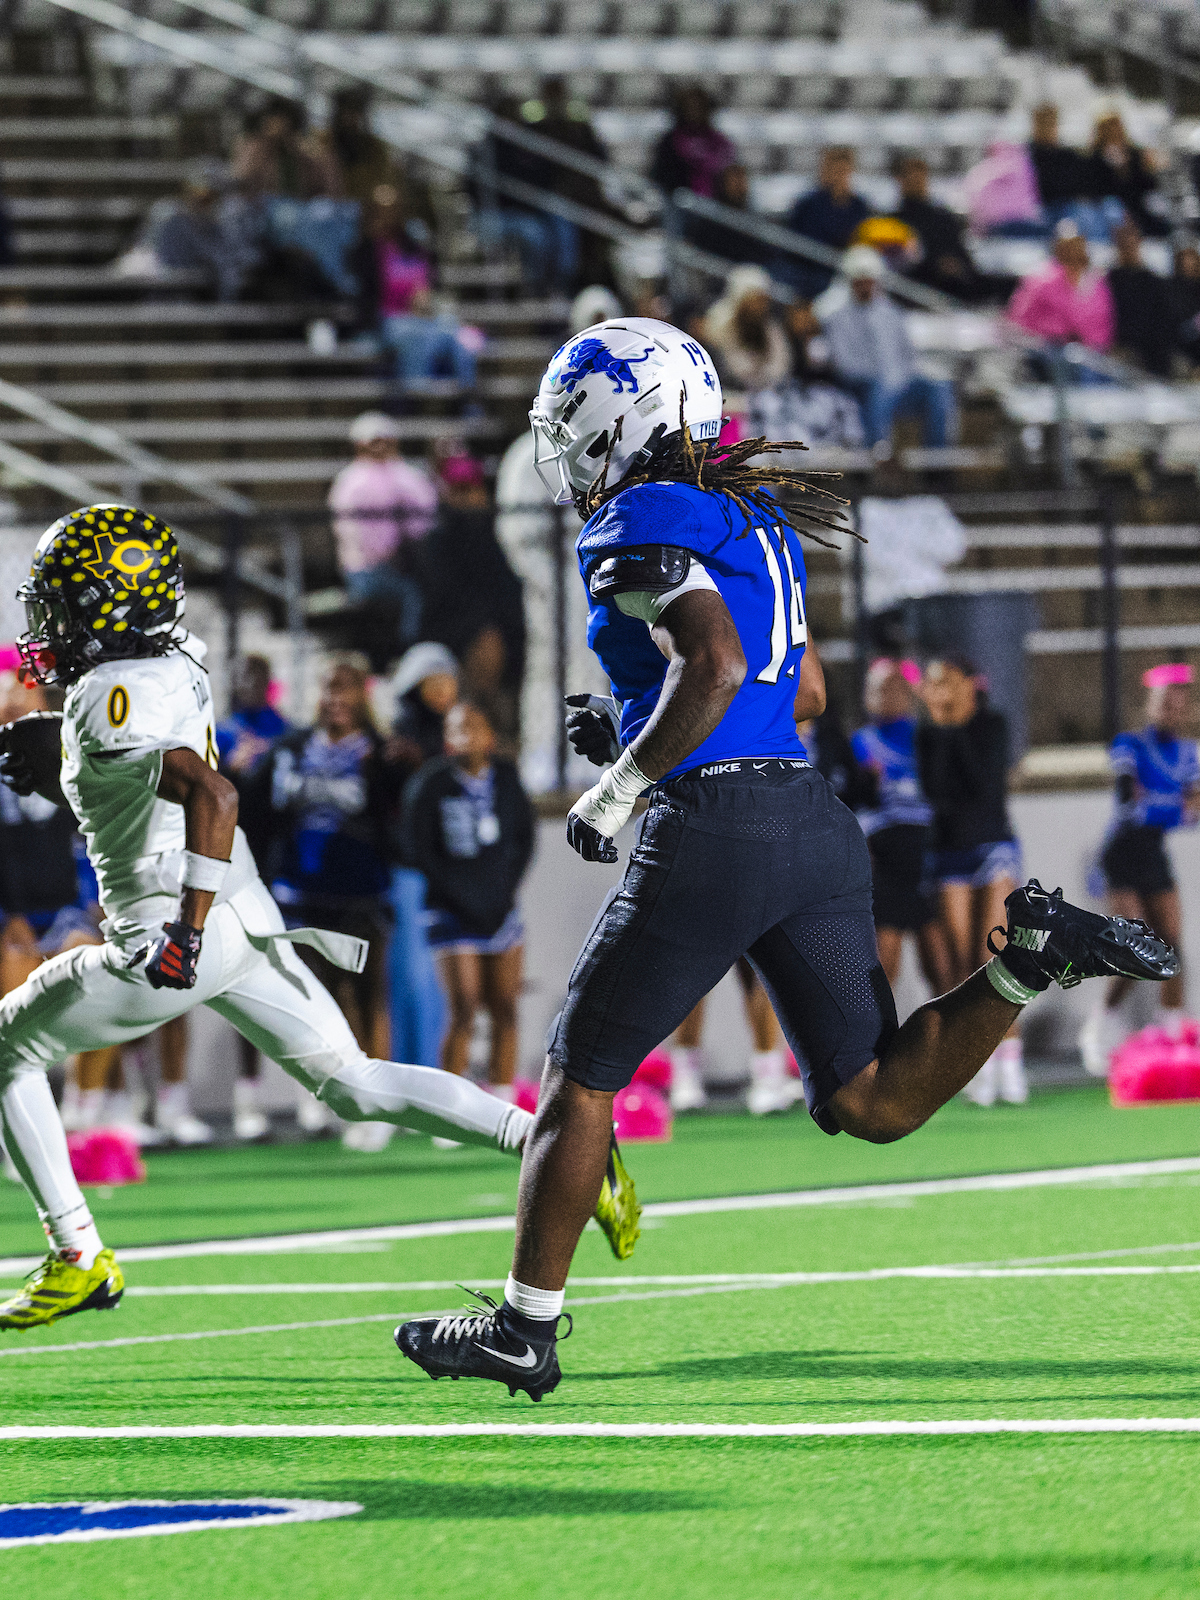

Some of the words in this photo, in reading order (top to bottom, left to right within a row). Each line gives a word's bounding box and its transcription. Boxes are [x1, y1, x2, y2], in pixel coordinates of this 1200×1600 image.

[680, 342, 707, 366] 14
[700, 420, 718, 439] TYLER
[108, 539, 154, 574] C
[753, 523, 808, 686] 14
[107, 684, 130, 728] 0
[700, 763, 741, 777] NIKE
[1011, 925, 1051, 952] NIKE
